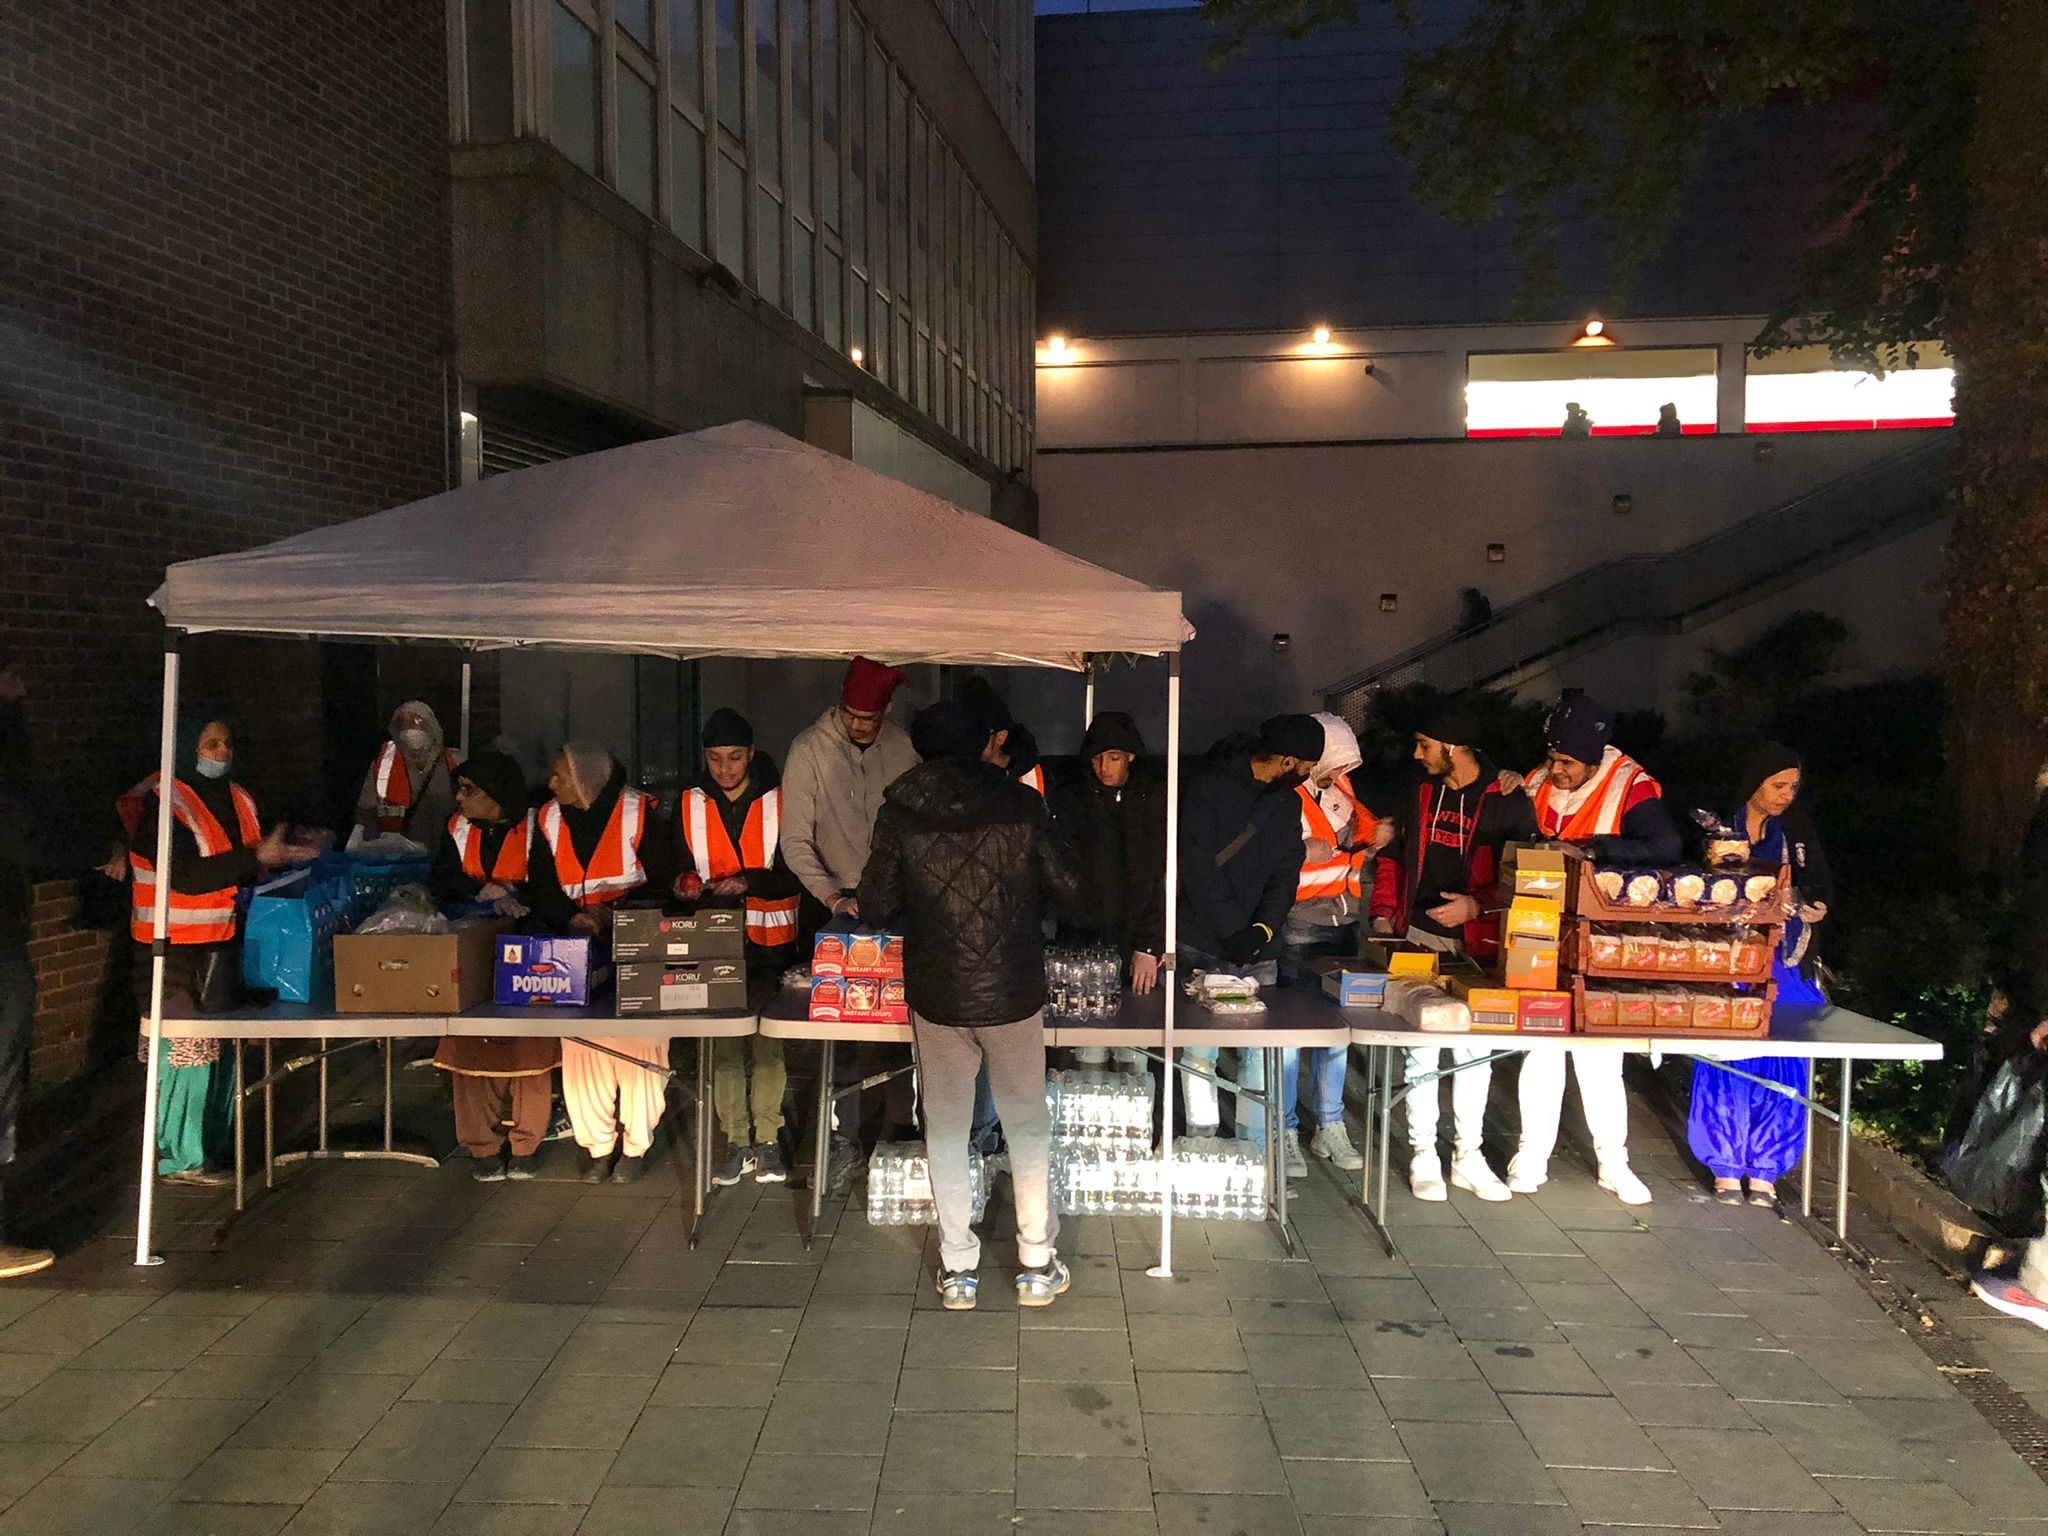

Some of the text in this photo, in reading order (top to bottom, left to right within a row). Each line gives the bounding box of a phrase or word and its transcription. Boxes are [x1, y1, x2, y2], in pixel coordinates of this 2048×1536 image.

[672, 920, 697, 929] KORU
[675, 973, 701, 982] KORU
[512, 975, 571, 993] PODIUM
